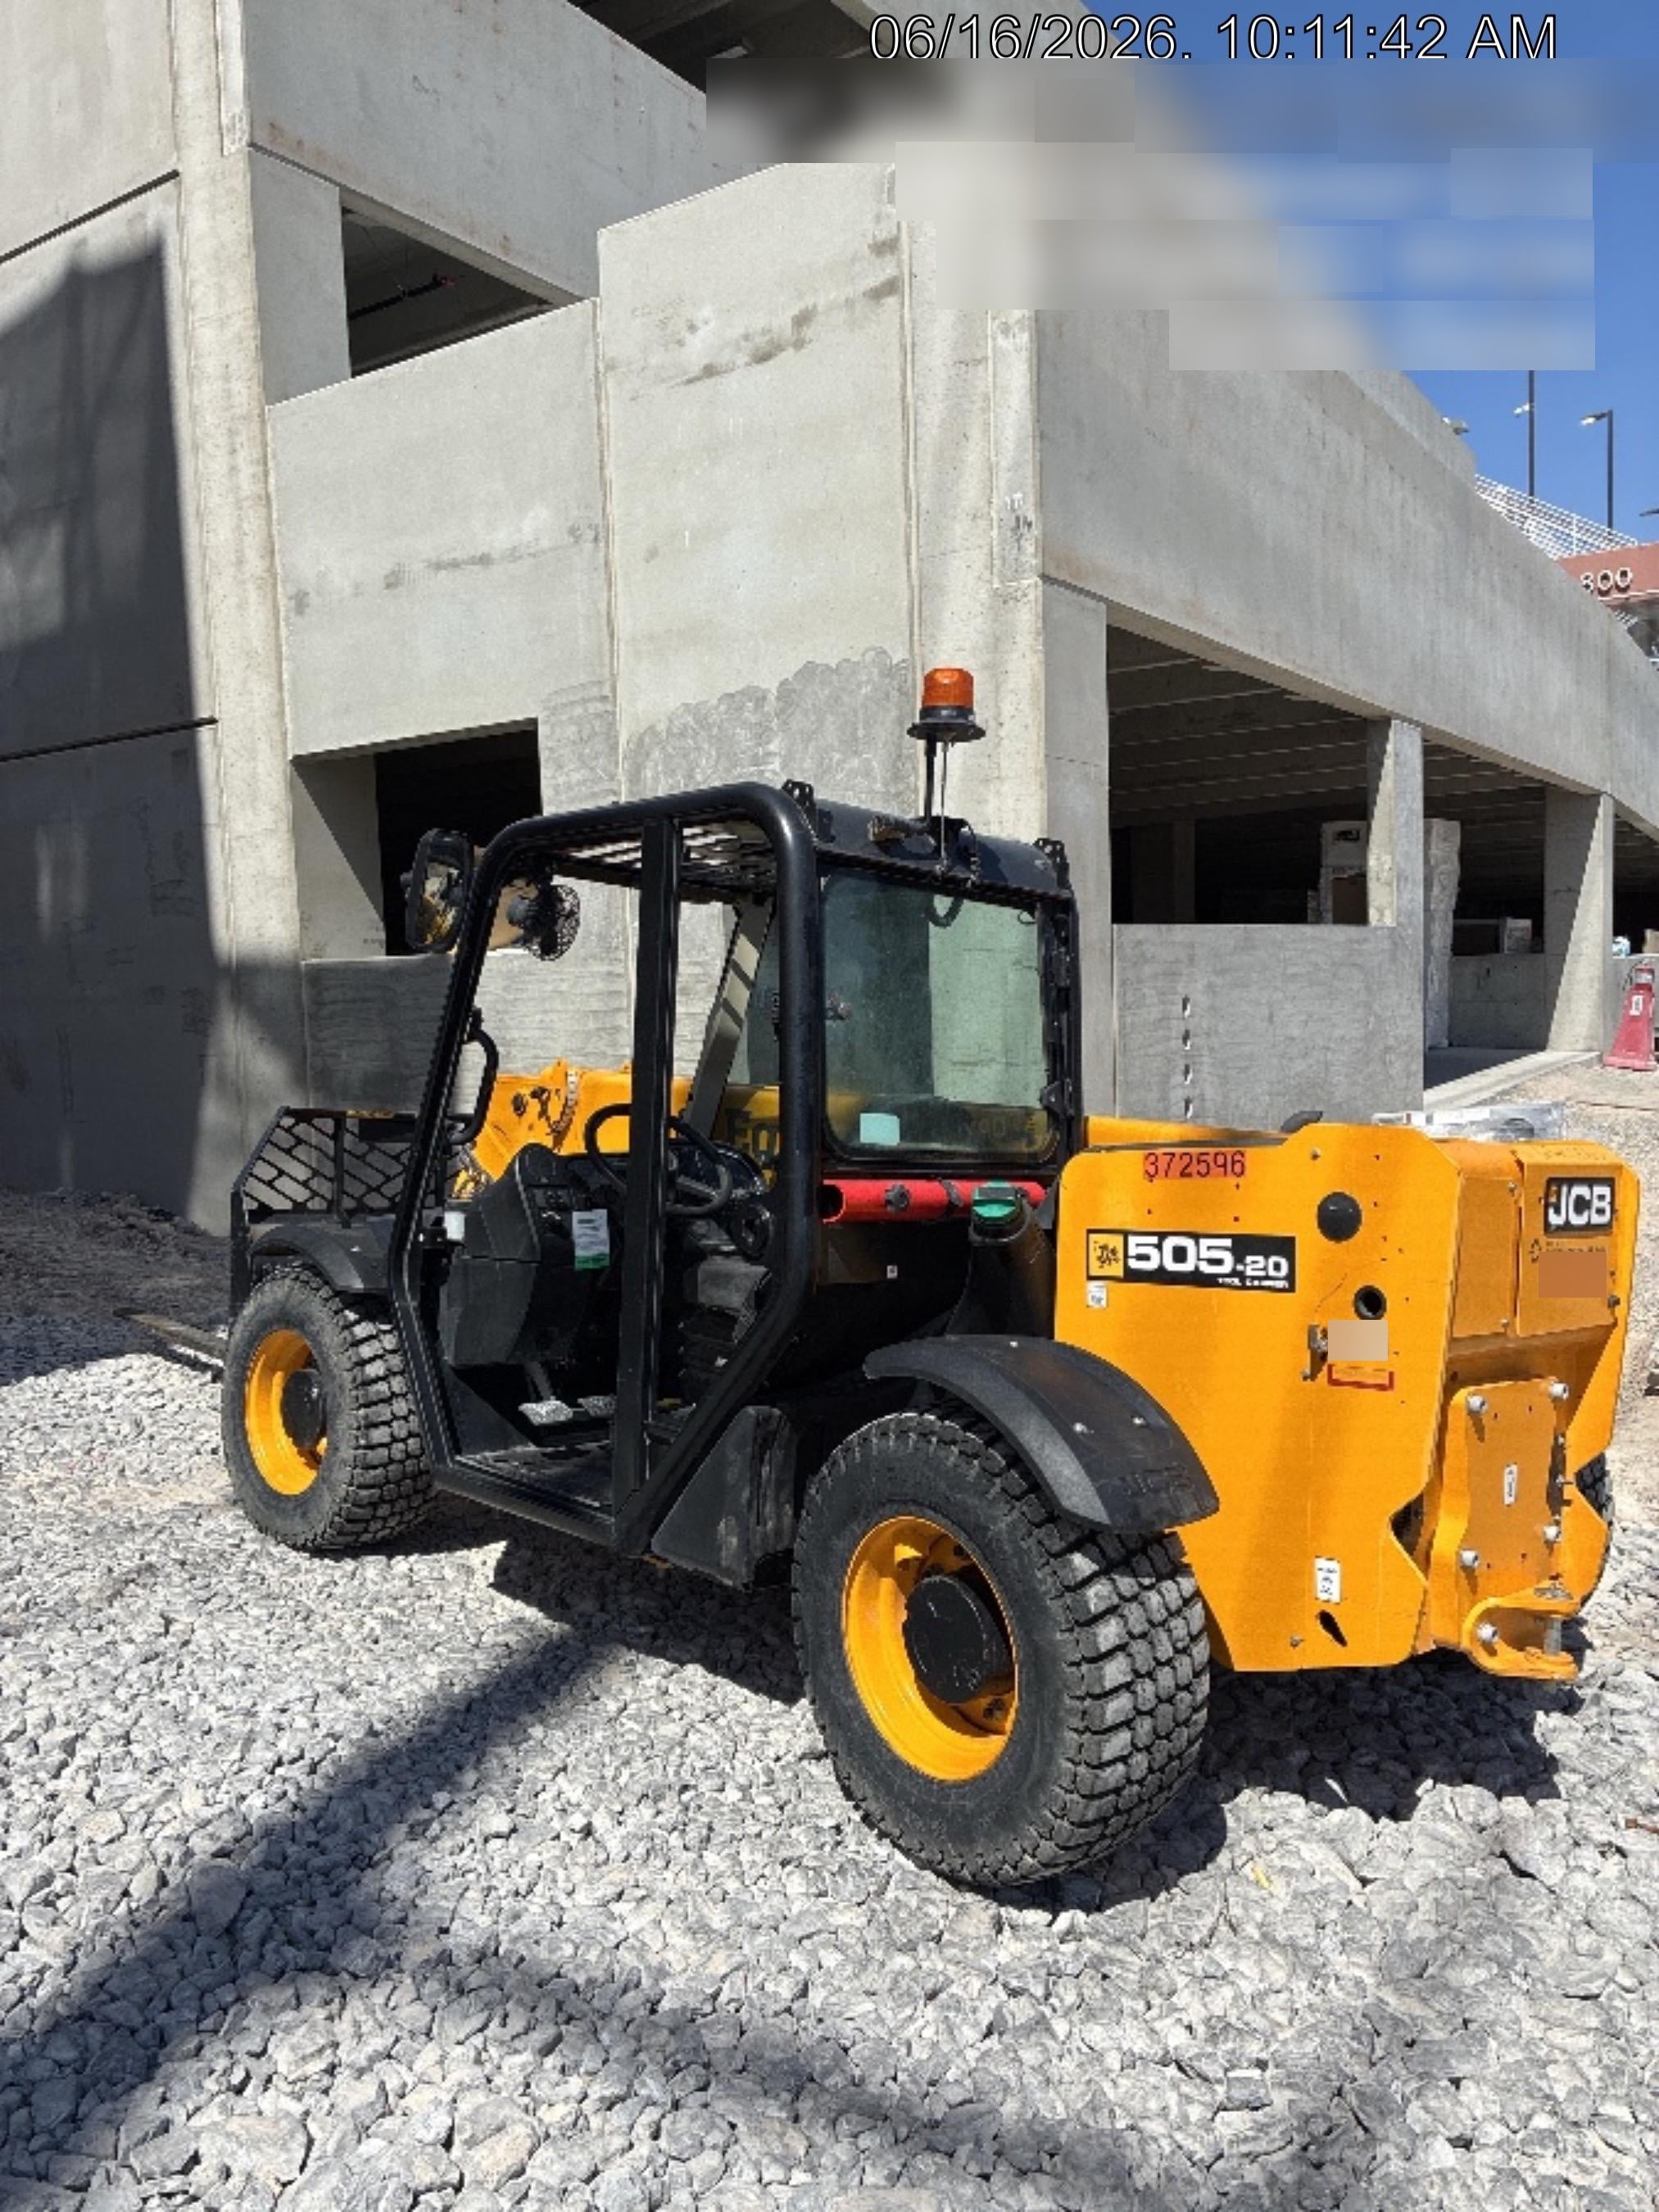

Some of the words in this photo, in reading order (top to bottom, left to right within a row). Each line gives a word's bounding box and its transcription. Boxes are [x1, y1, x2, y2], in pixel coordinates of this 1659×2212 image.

[1145, 1151, 1245, 1178] 372596
[1548, 1184, 1611, 1226] JCB
[1126, 1235, 1289, 1278] 505-20
